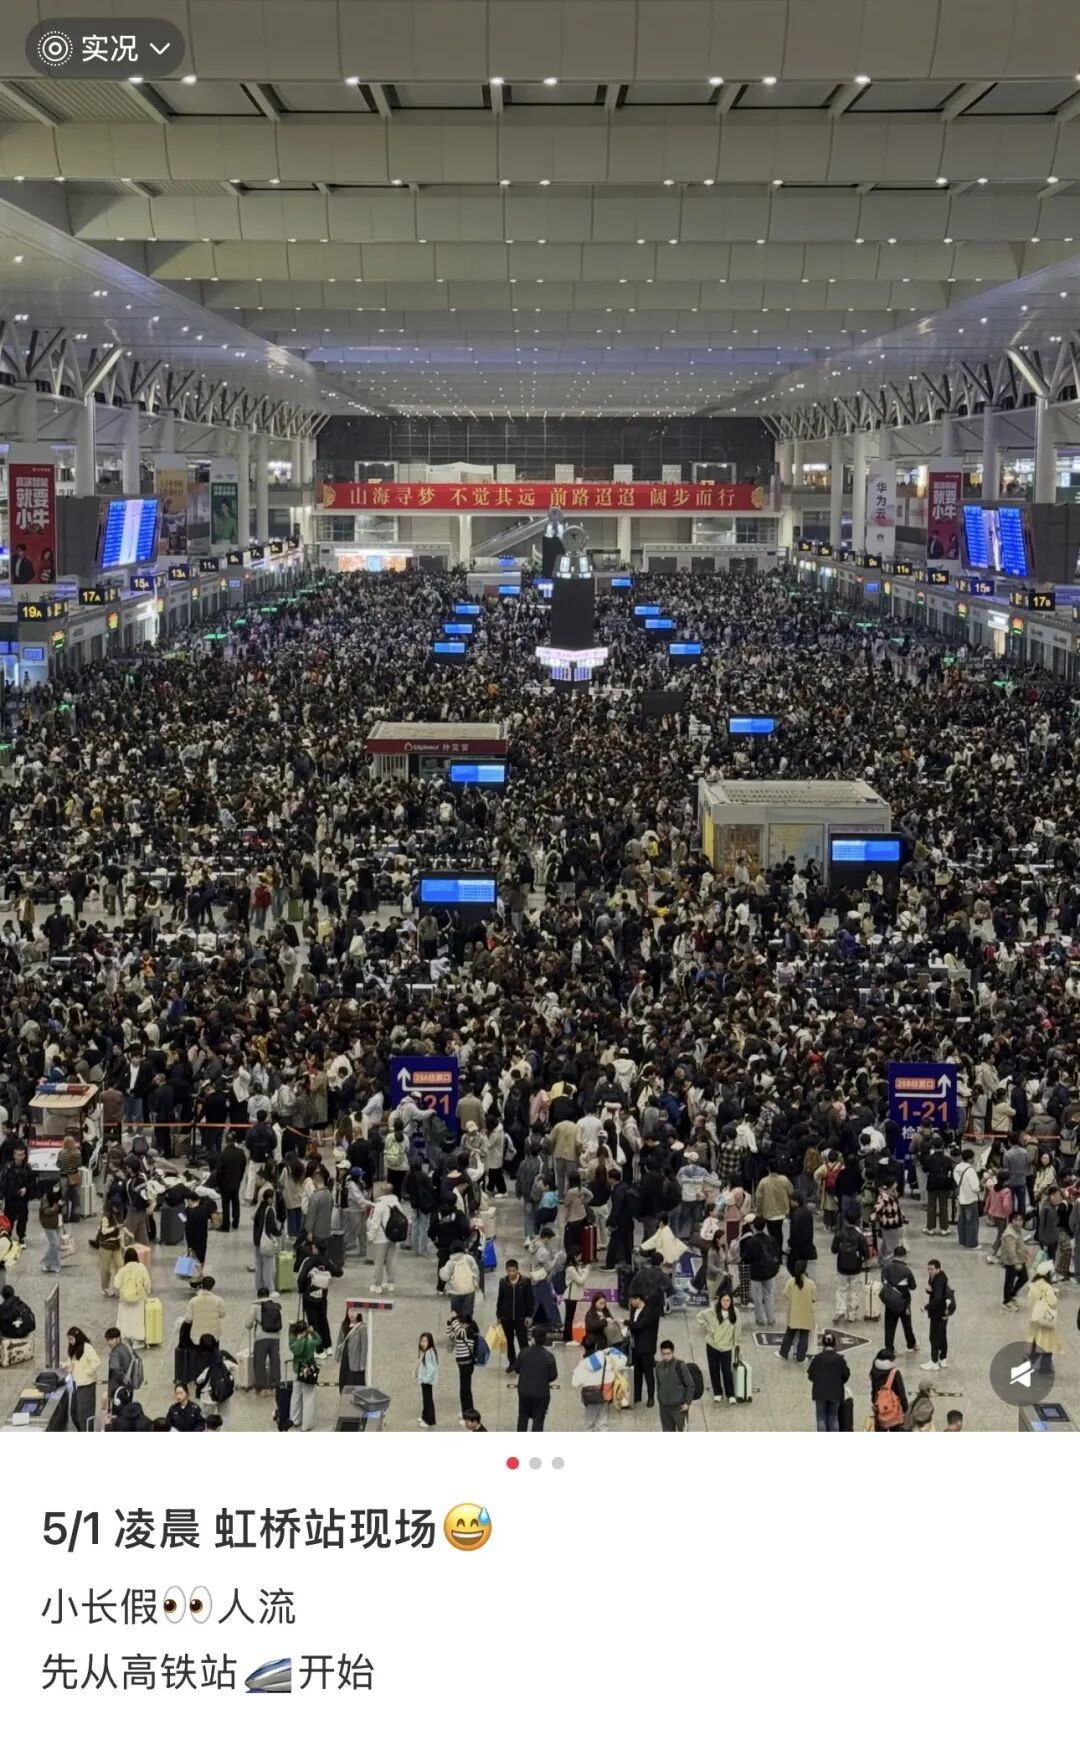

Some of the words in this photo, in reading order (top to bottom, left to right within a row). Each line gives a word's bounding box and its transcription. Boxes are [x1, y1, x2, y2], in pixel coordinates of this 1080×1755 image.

[16, 488, 49, 509] 就要
[350, 487, 436, 505] 山海寻梦
[450, 487, 536, 506] 不觉其远
[550, 487, 635, 507] 前路迢迢
[650, 487, 736, 507] 阔步而行
[876, 481, 888, 519] 华为云
[932, 489, 958, 504] 就要
[15, 508, 50, 530] 小牛
[932, 504, 957, 520] 小牛
[203, 561, 216, 570] 11A
[171, 568, 187, 579] 13A
[133, 577, 151, 588] 15A
[975, 583, 991, 593] 15B
[82, 590, 101, 602] 17A
[1033, 596, 1052, 608] 17B
[22, 605, 43, 619] 19A
[442, 743, 469, 752] 外交官
[898, 1100, 949, 1122] 1-21
